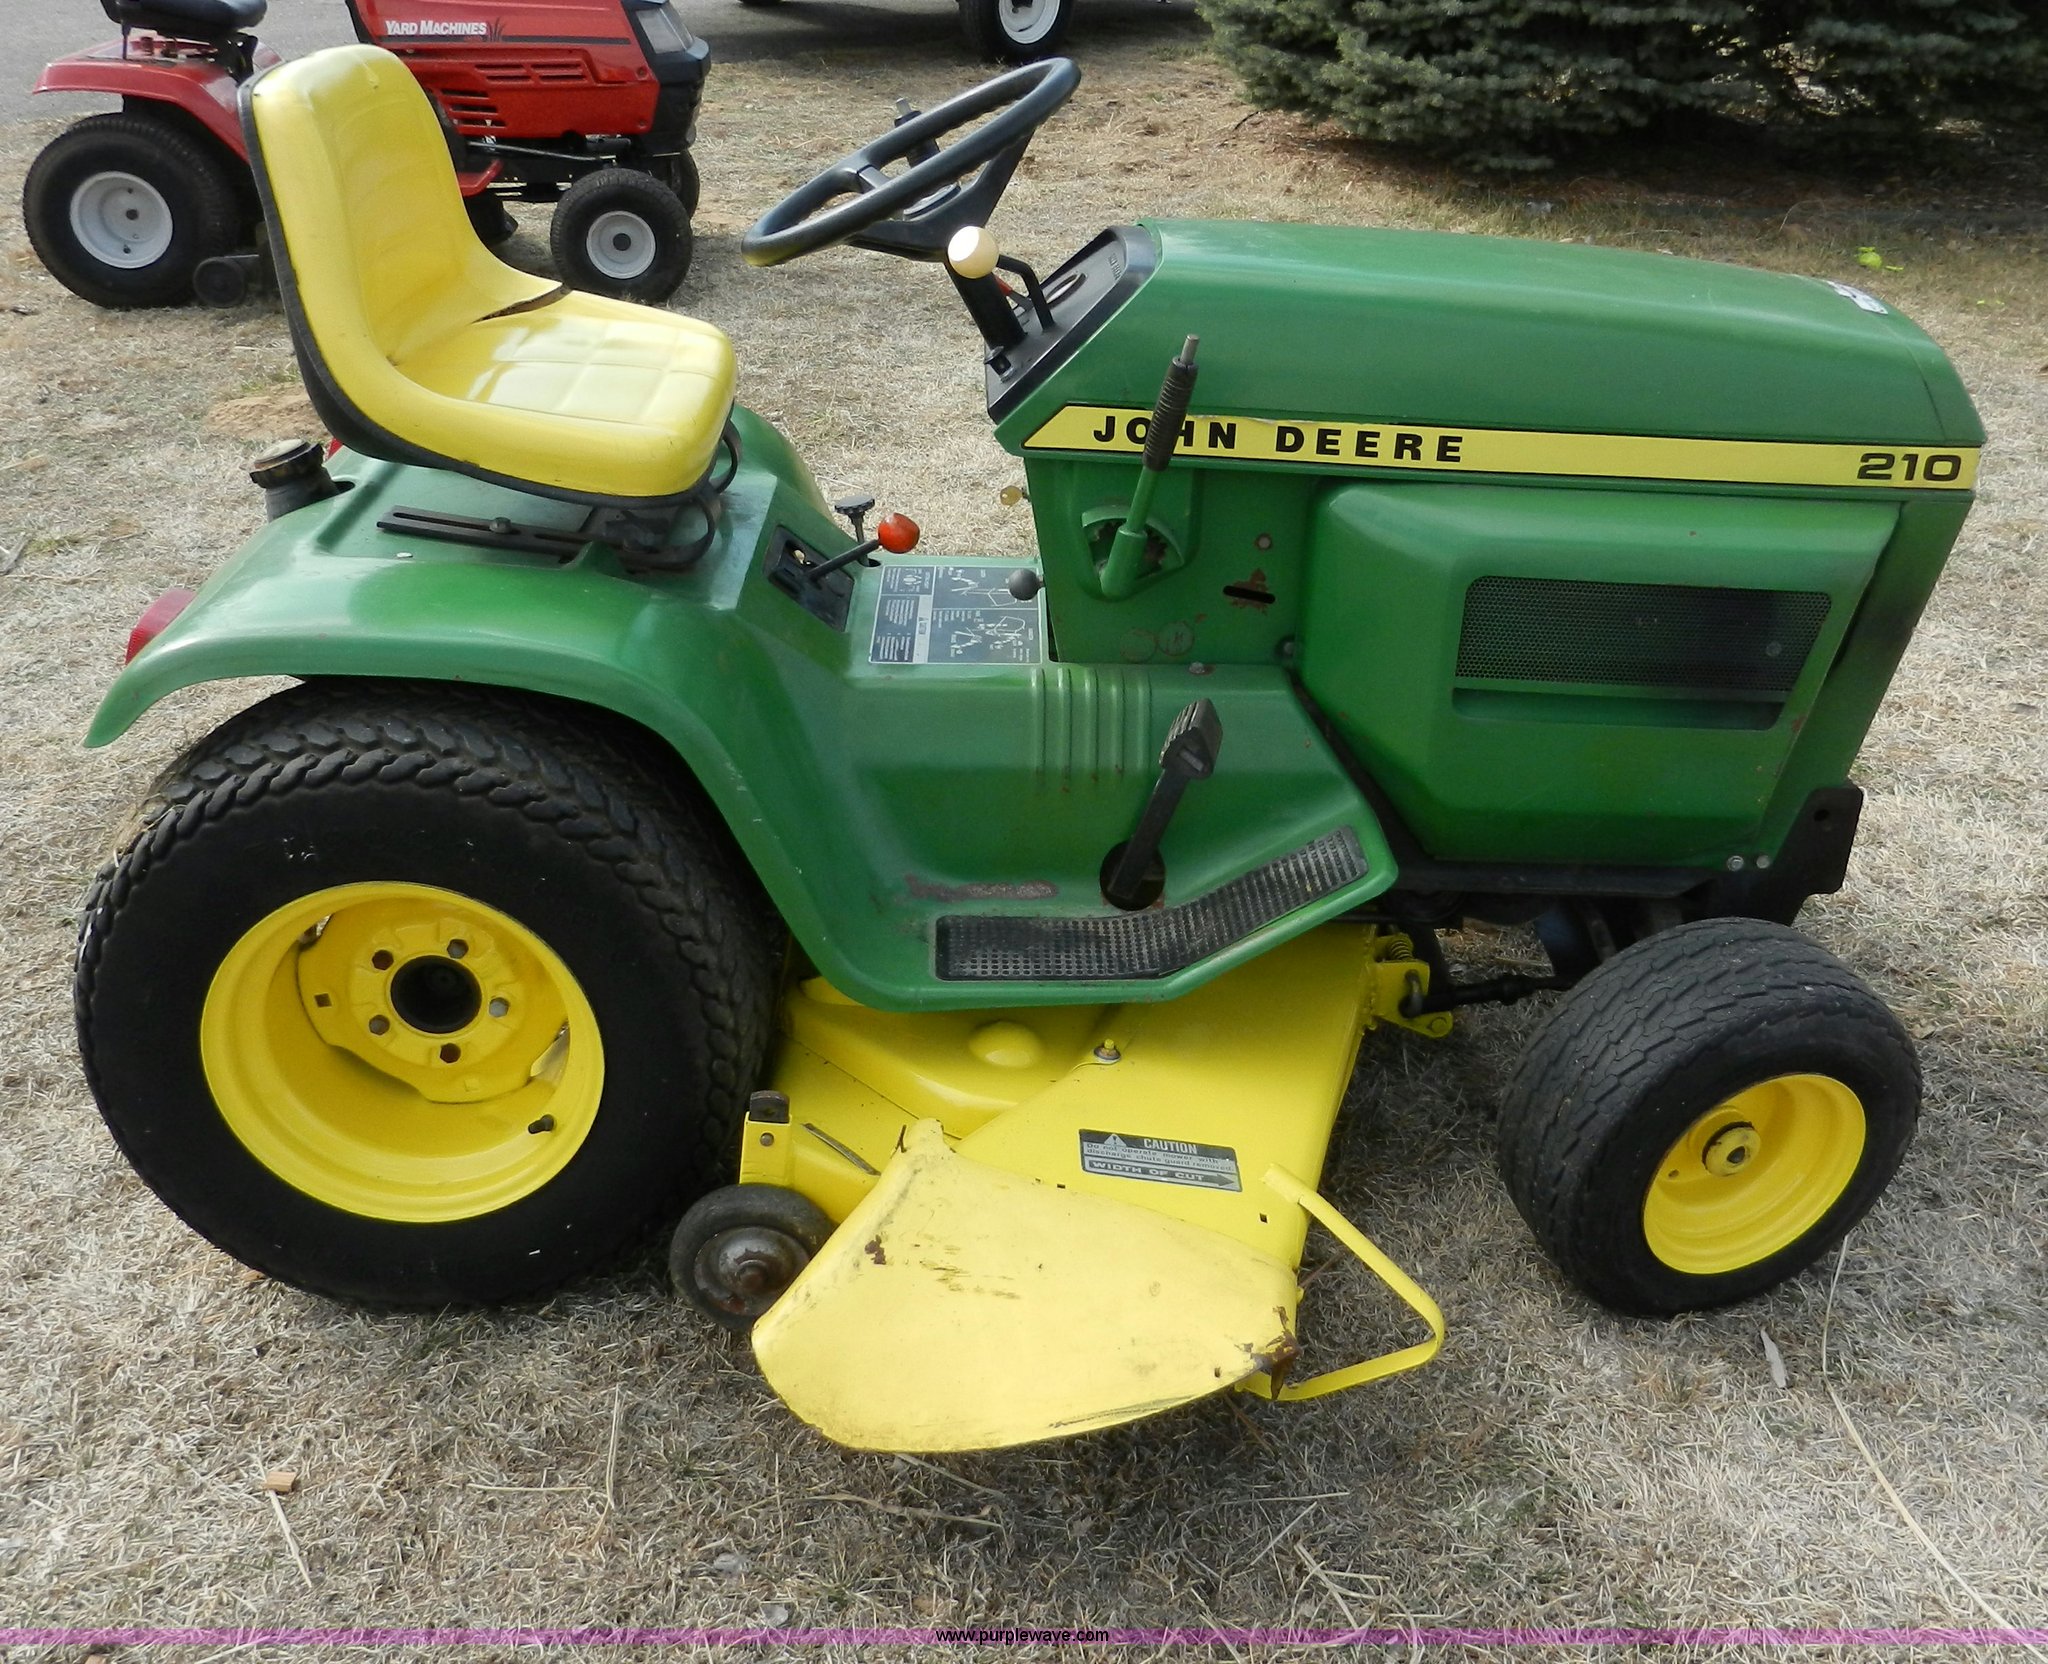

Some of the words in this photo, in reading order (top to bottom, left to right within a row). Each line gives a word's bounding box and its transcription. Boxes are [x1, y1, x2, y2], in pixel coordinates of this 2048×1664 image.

[385, 20, 419, 35] YARD
[420, 20, 488, 35] MACHINES
[1275, 425, 1464, 463] DEERE
[1857, 452, 1962, 482] 210
[1143, 1138, 1198, 1155] CAUTION
[1093, 1161, 1142, 1174] WIDTH
[1149, 1168, 1169, 1176] OF
[1175, 1172, 1204, 1181] CUT
